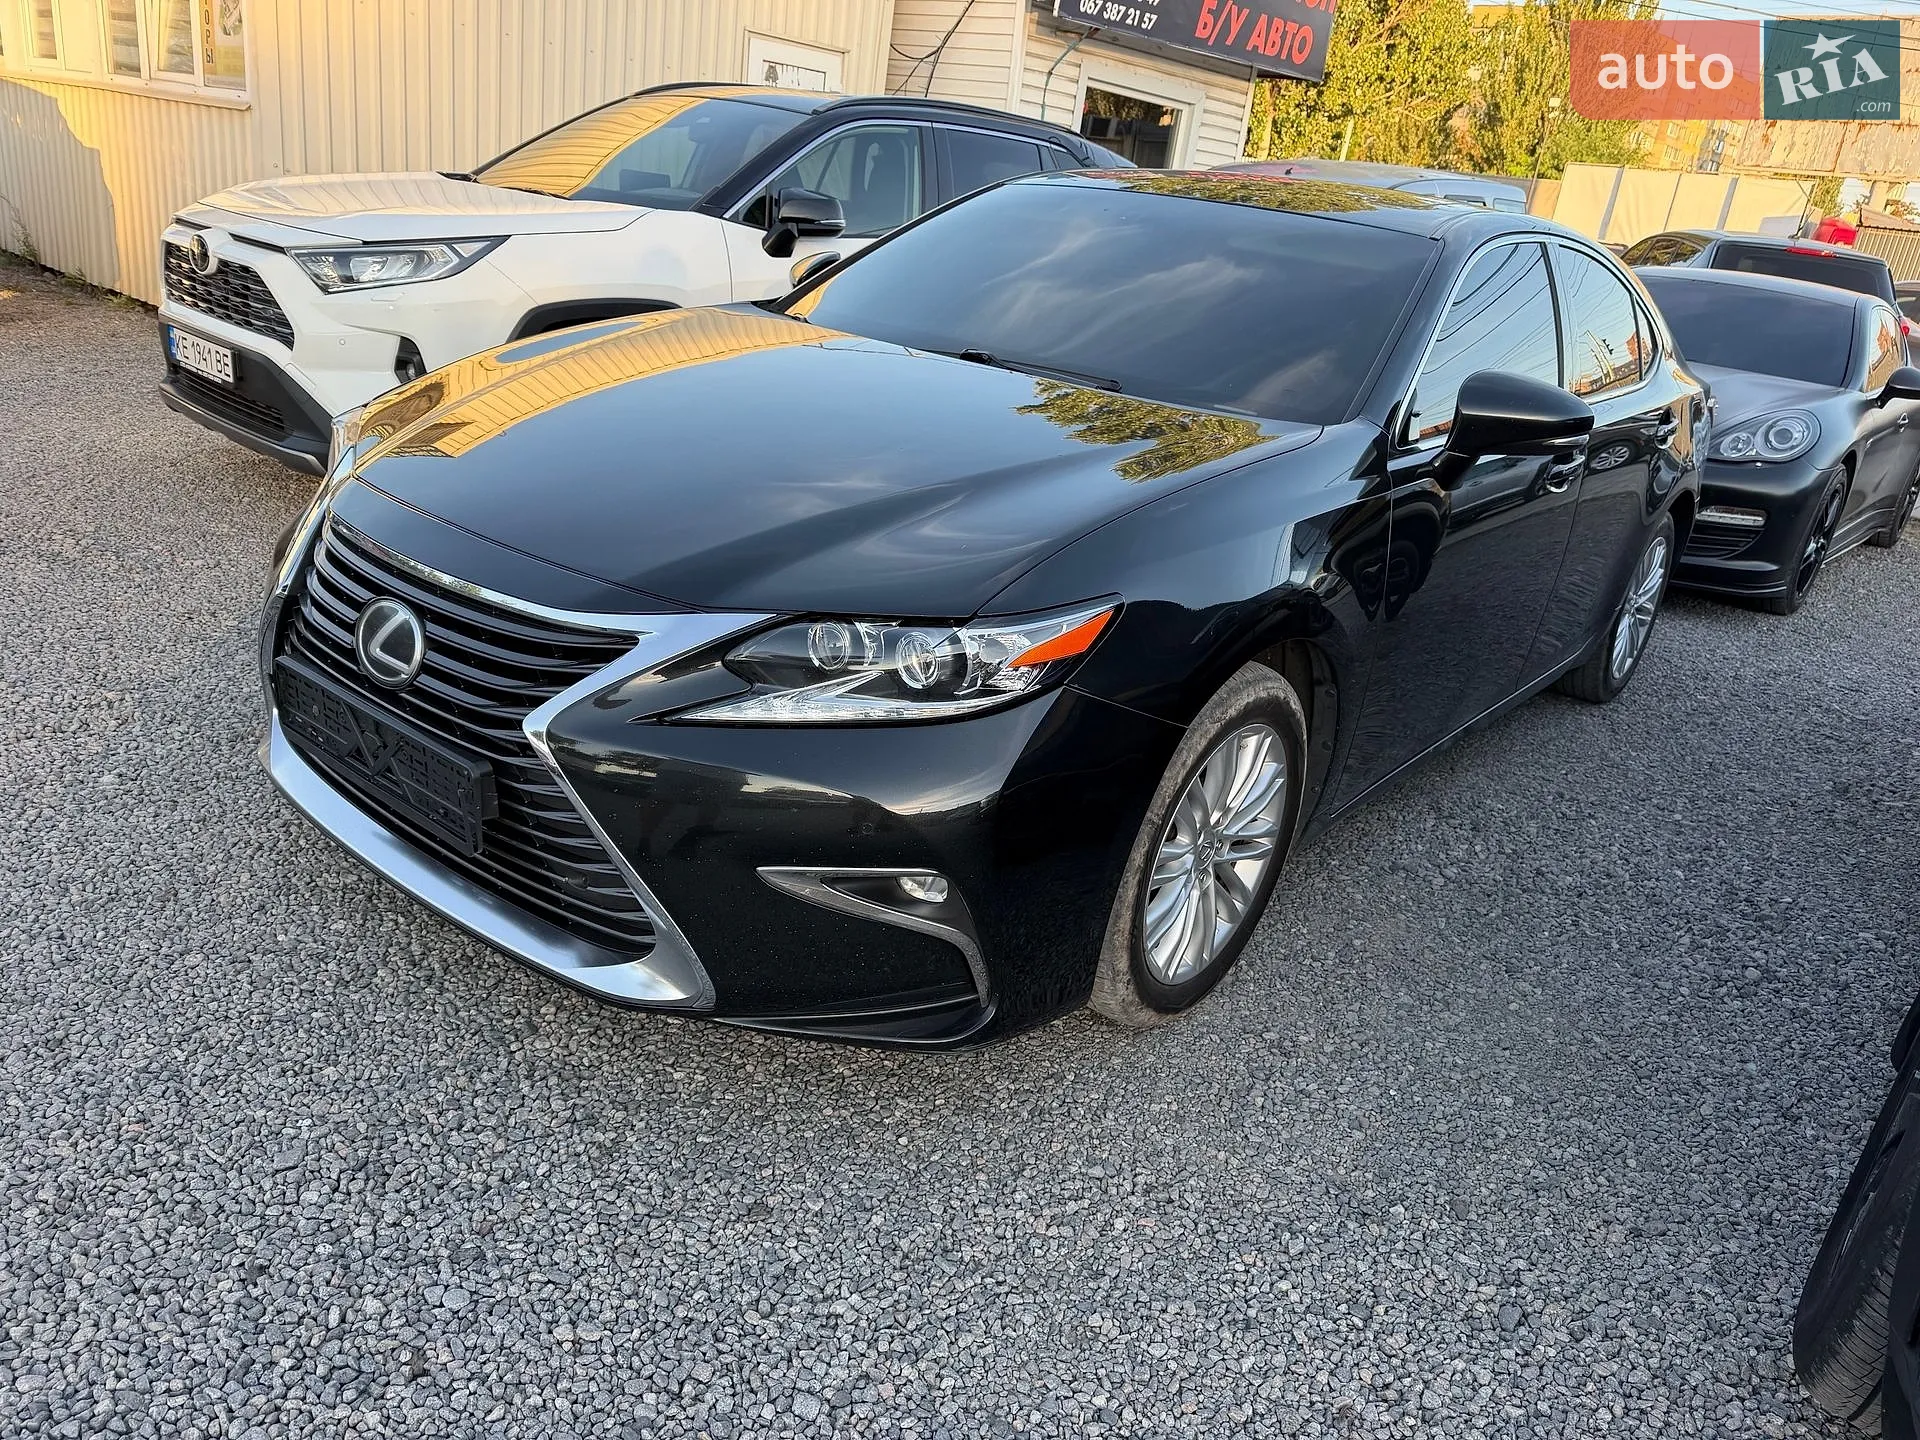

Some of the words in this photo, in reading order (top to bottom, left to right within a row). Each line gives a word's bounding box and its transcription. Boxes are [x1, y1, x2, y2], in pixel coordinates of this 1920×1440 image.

[204, 0, 214, 64] ОРЫ
[1079, 0, 1103, 15] 067
[1103, 2, 1126, 22] 387
[1125, 8, 1141, 26] 21
[1141, 12, 1158, 30] 57
[1195, 0, 1249, 46] Б/У
[1246, 13, 1314, 65] АВТО
[174, 333, 189, 360] KE
[191, 340, 213, 371] 1941
[214, 350, 231, 378] BE
